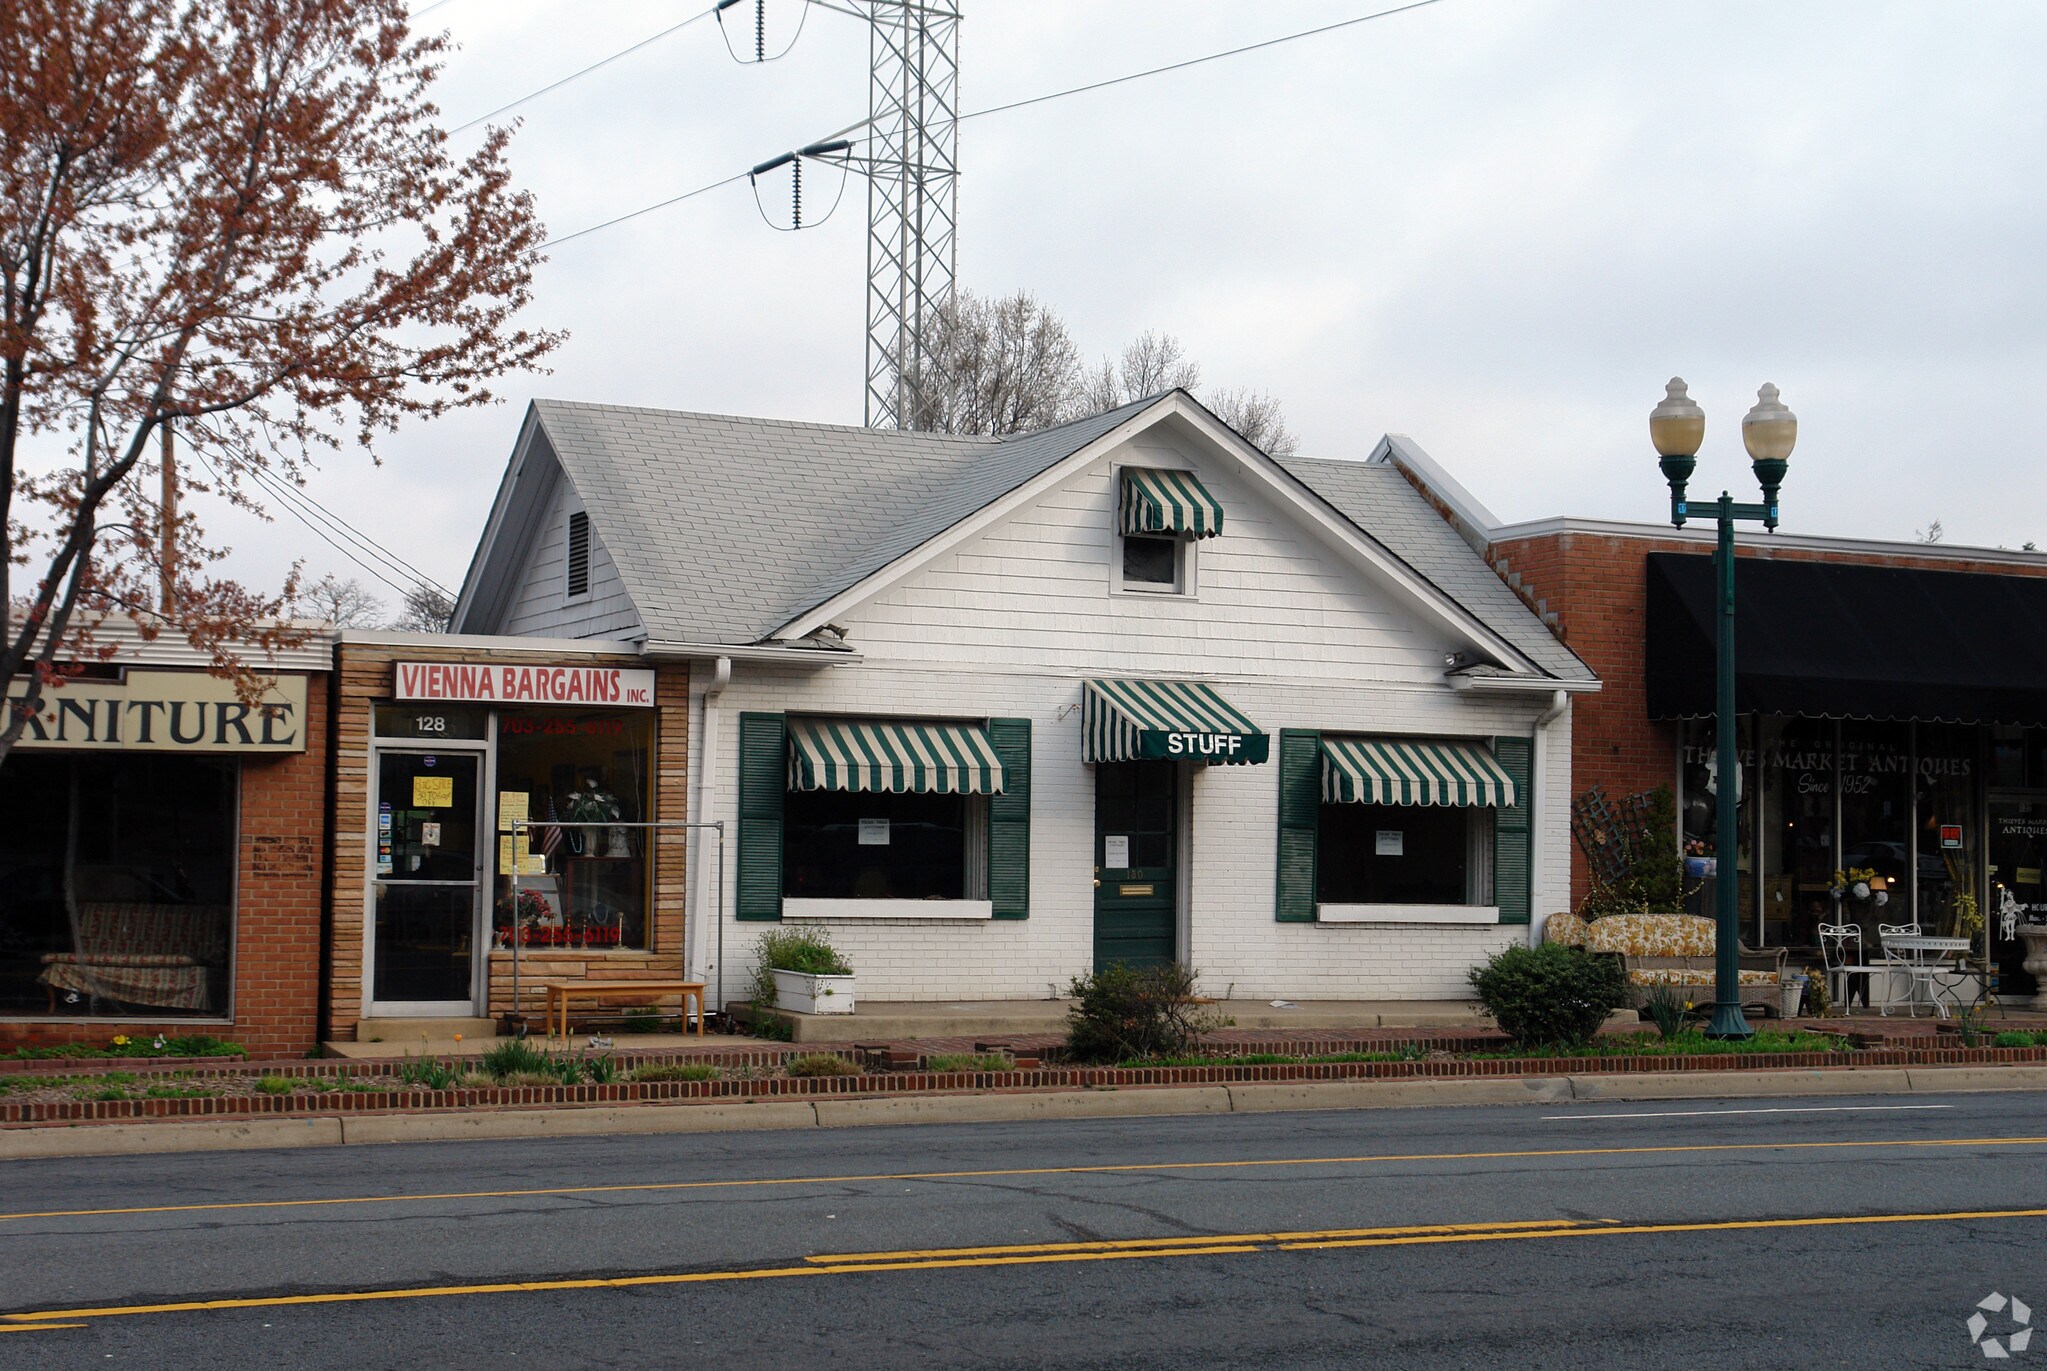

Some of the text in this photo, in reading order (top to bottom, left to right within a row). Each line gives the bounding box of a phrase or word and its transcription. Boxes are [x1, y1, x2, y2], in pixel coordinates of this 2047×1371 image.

[401, 664, 650, 703] VIENNA BARGAINS INC.
[416, 716, 446, 732] 128
[1167, 732, 1242, 755] STUFF
[1683, 745, 1972, 786] THVES MARKET ANTIQUES
[1797, 773, 1872, 794] Since 1952
